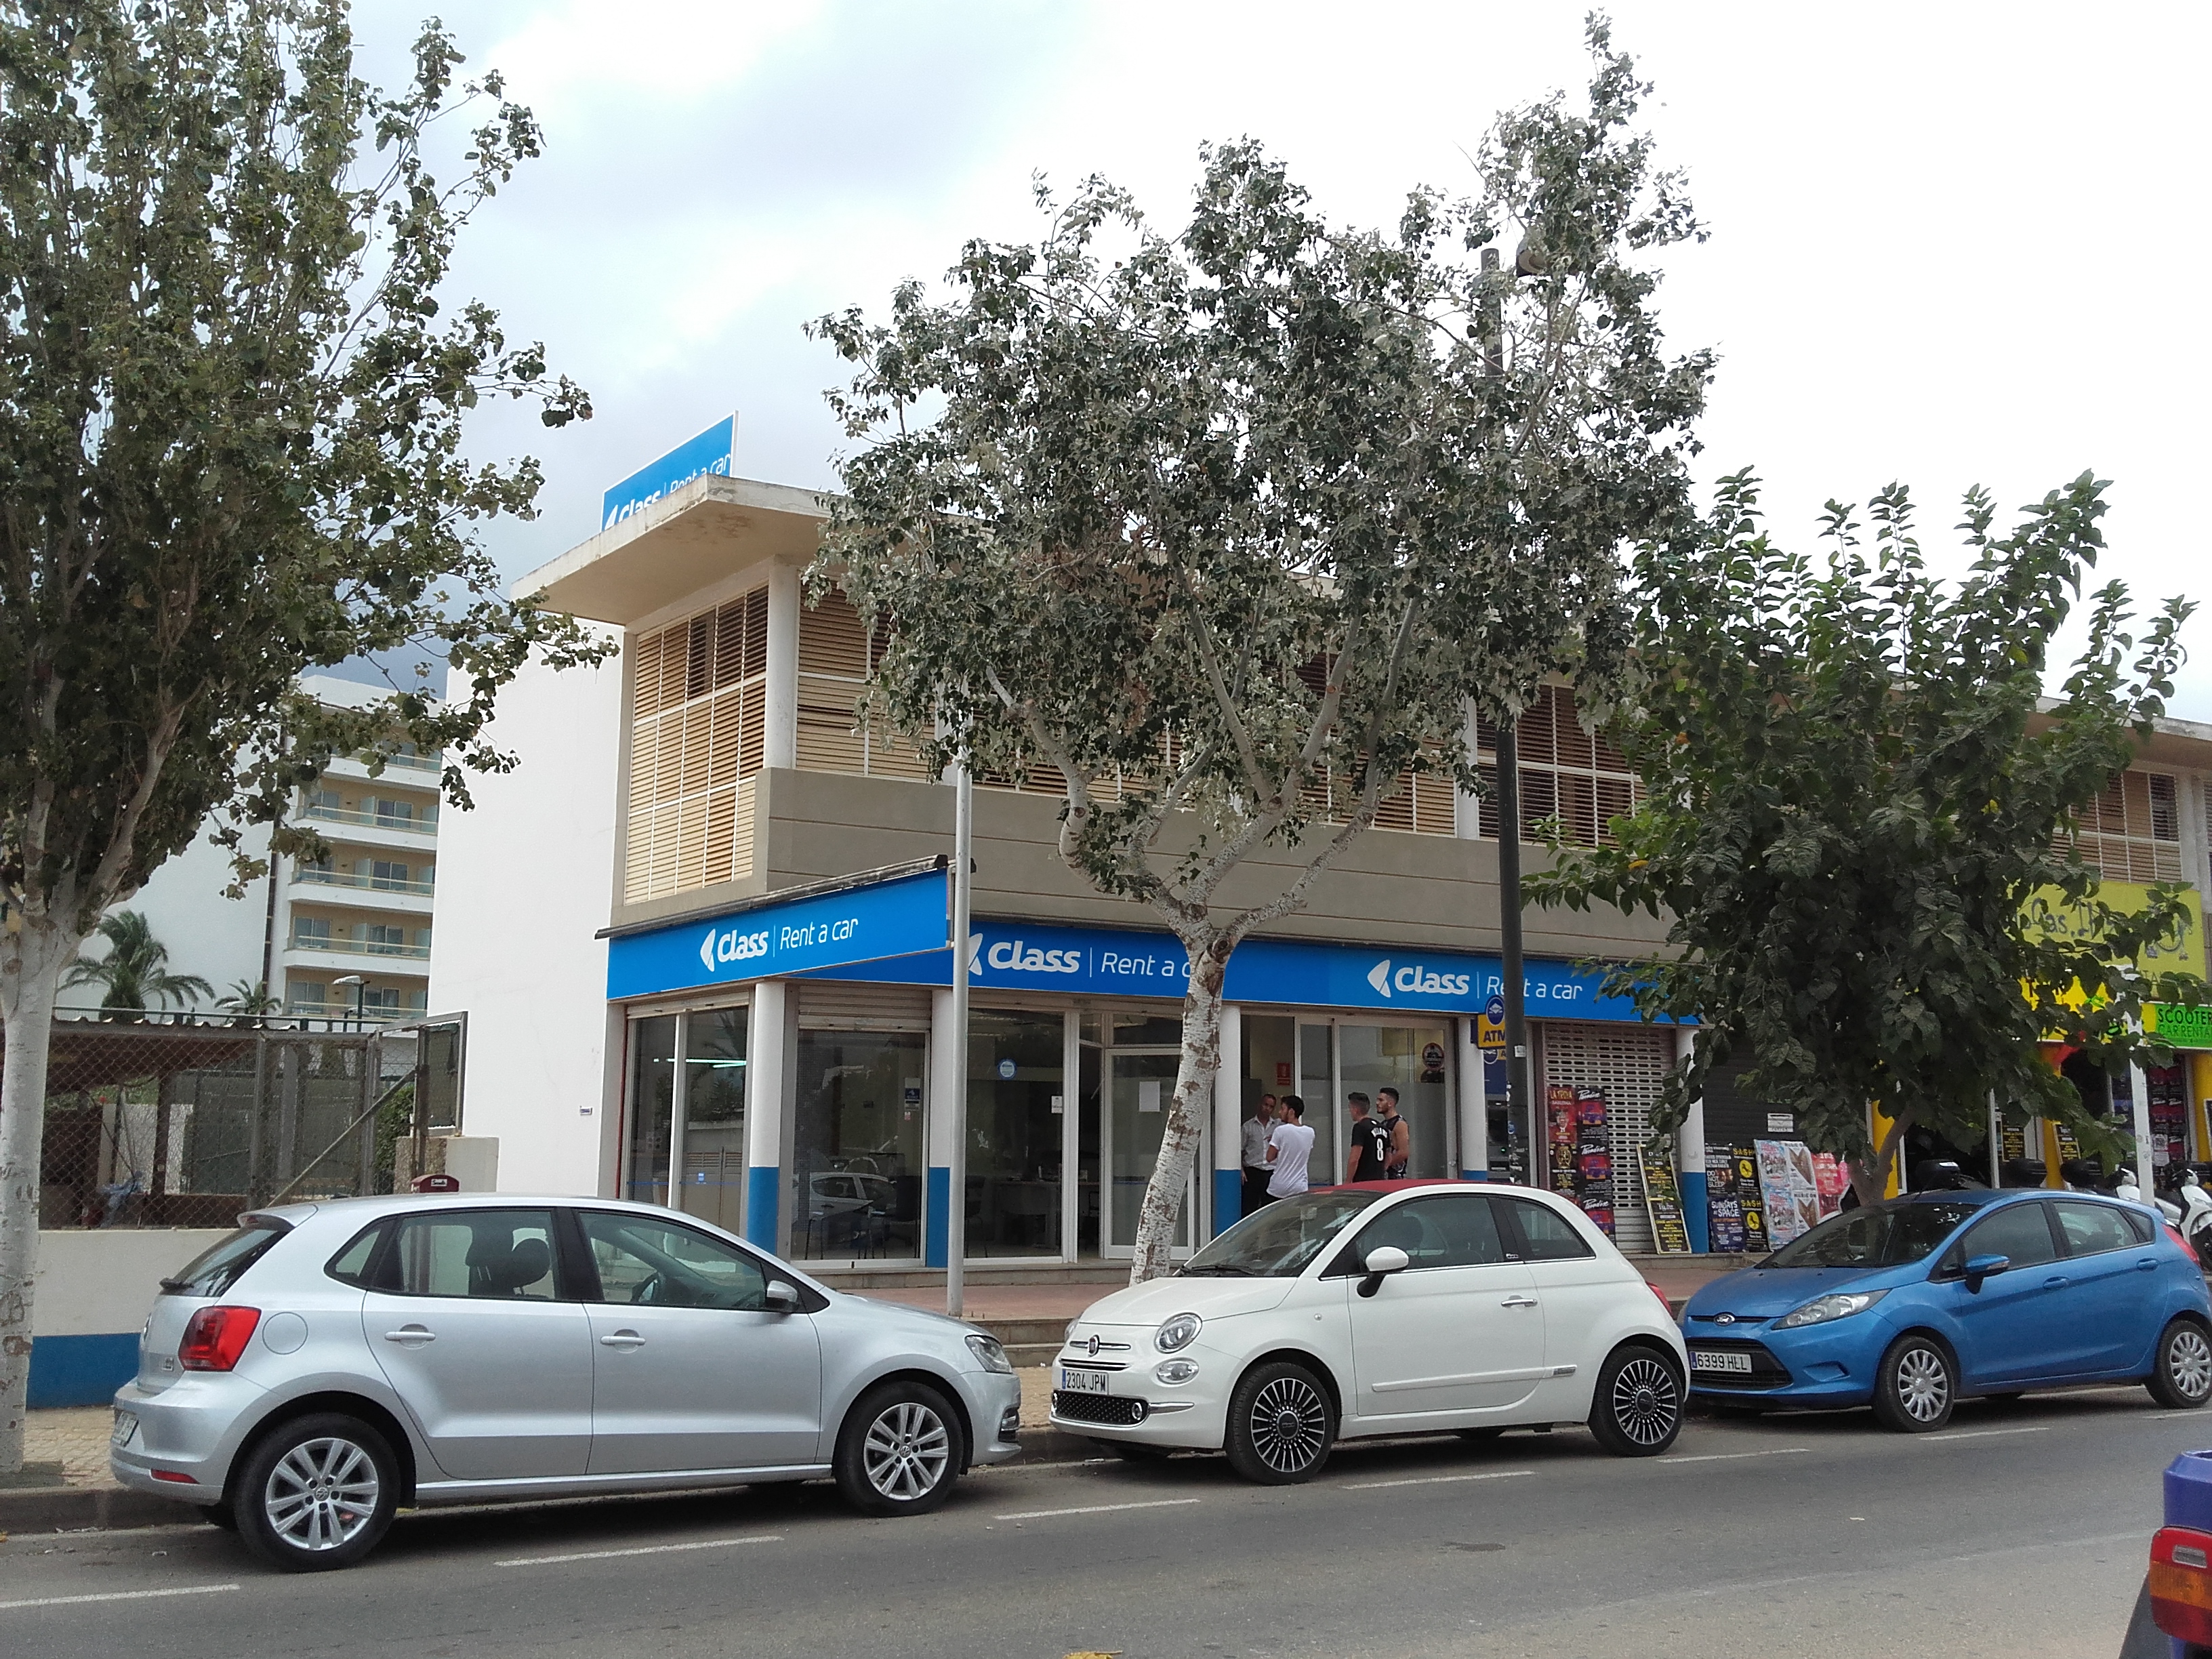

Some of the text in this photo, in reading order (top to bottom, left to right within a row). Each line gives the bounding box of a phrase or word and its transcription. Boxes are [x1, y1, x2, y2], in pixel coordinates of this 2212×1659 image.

[710, 453, 731, 474] car
[717, 918, 859, 963] Class Rent a car
[988, 940, 1081, 973] Class
[1101, 952, 1155, 975] Rent
[1161, 960, 1174, 977] a
[1395, 966, 1470, 995] Class
[1536, 983, 1547, 998] a
[1552, 984, 1583, 1000] car
[1483, 1029, 1506, 1042] ATM
[2181, 1025, 2212, 1038] RENTA
[1376, 1138, 1384, 1162] 8
[1717, 1209, 1740, 1217] SPACE
[1697, 1354, 1747, 1370] 6399 HLL
[1066, 1372, 1105, 1392] 2304 JPM
